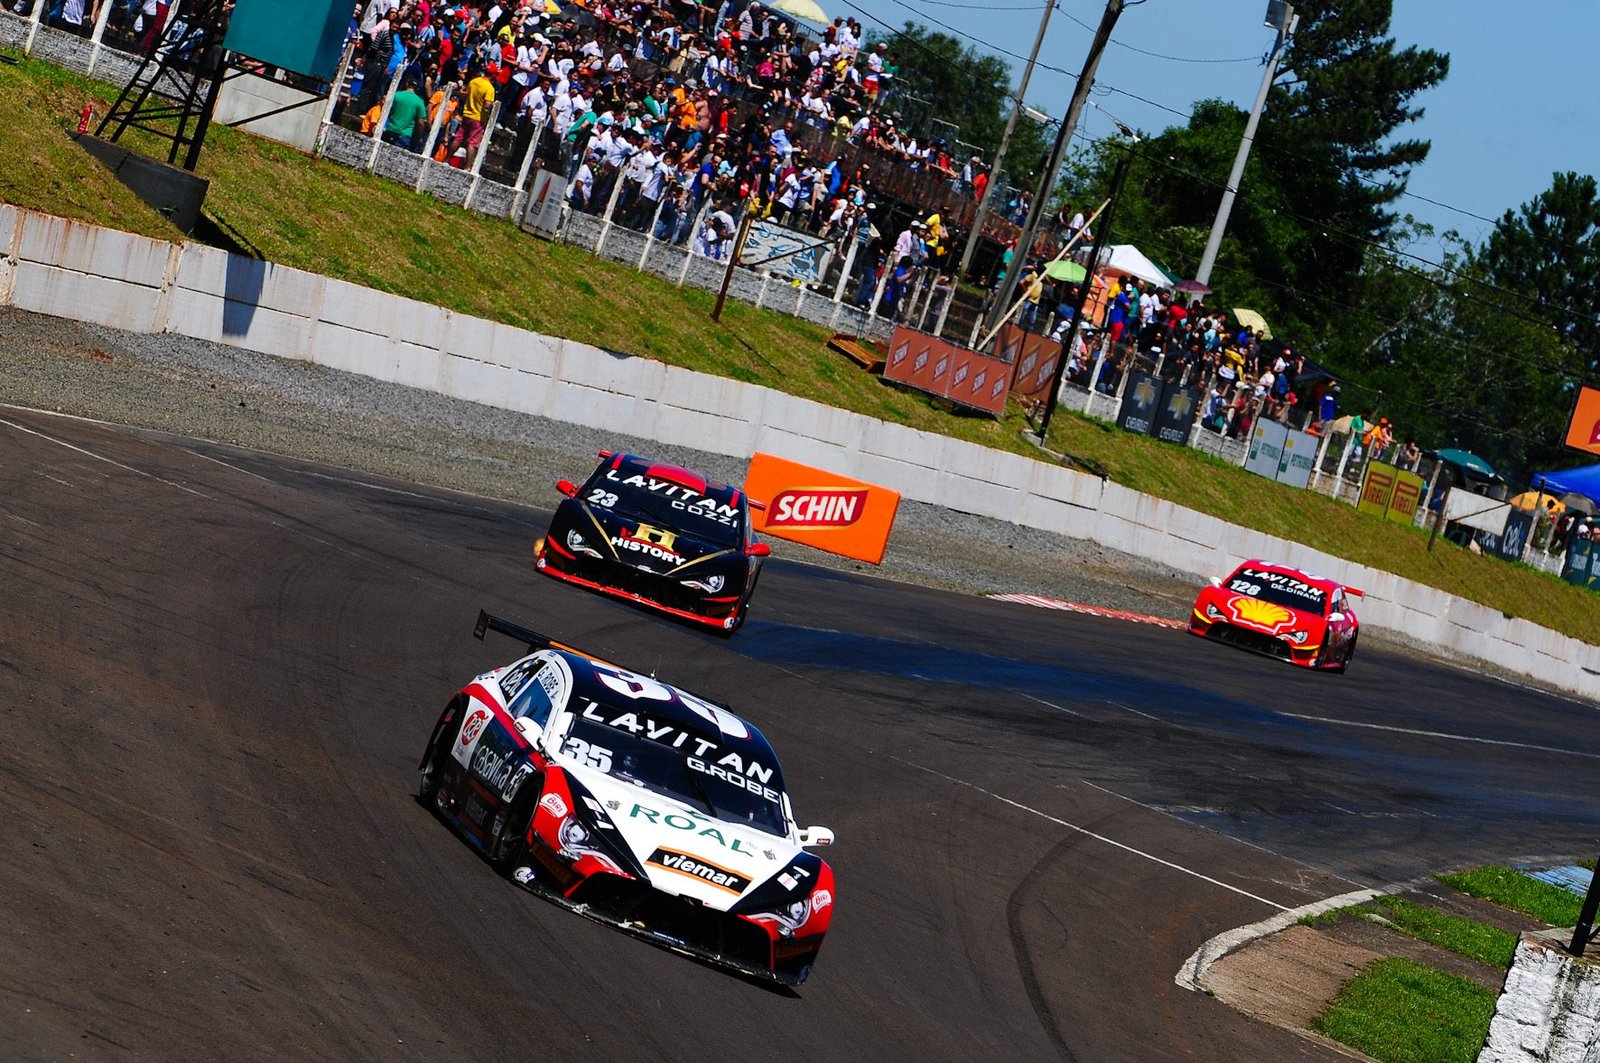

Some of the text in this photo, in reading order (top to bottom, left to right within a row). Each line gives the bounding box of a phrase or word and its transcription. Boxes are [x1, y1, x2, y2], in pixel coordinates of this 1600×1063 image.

[587, 488, 619, 509] 23
[606, 469, 740, 518] LAVITAN
[775, 494, 858, 522] SCHIN
[671, 500, 738, 528] COZZI
[611, 536, 687, 566] HISTORY
[1230, 579, 1261, 596] 128
[1243, 568, 1324, 597] LAVITAN
[565, 737, 614, 774] 35
[581, 702, 774, 784] LAVITAN
[686, 756, 780, 805] G.ROBE
[629, 803, 754, 858] ROAL
[662, 854, 739, 887] viemar
